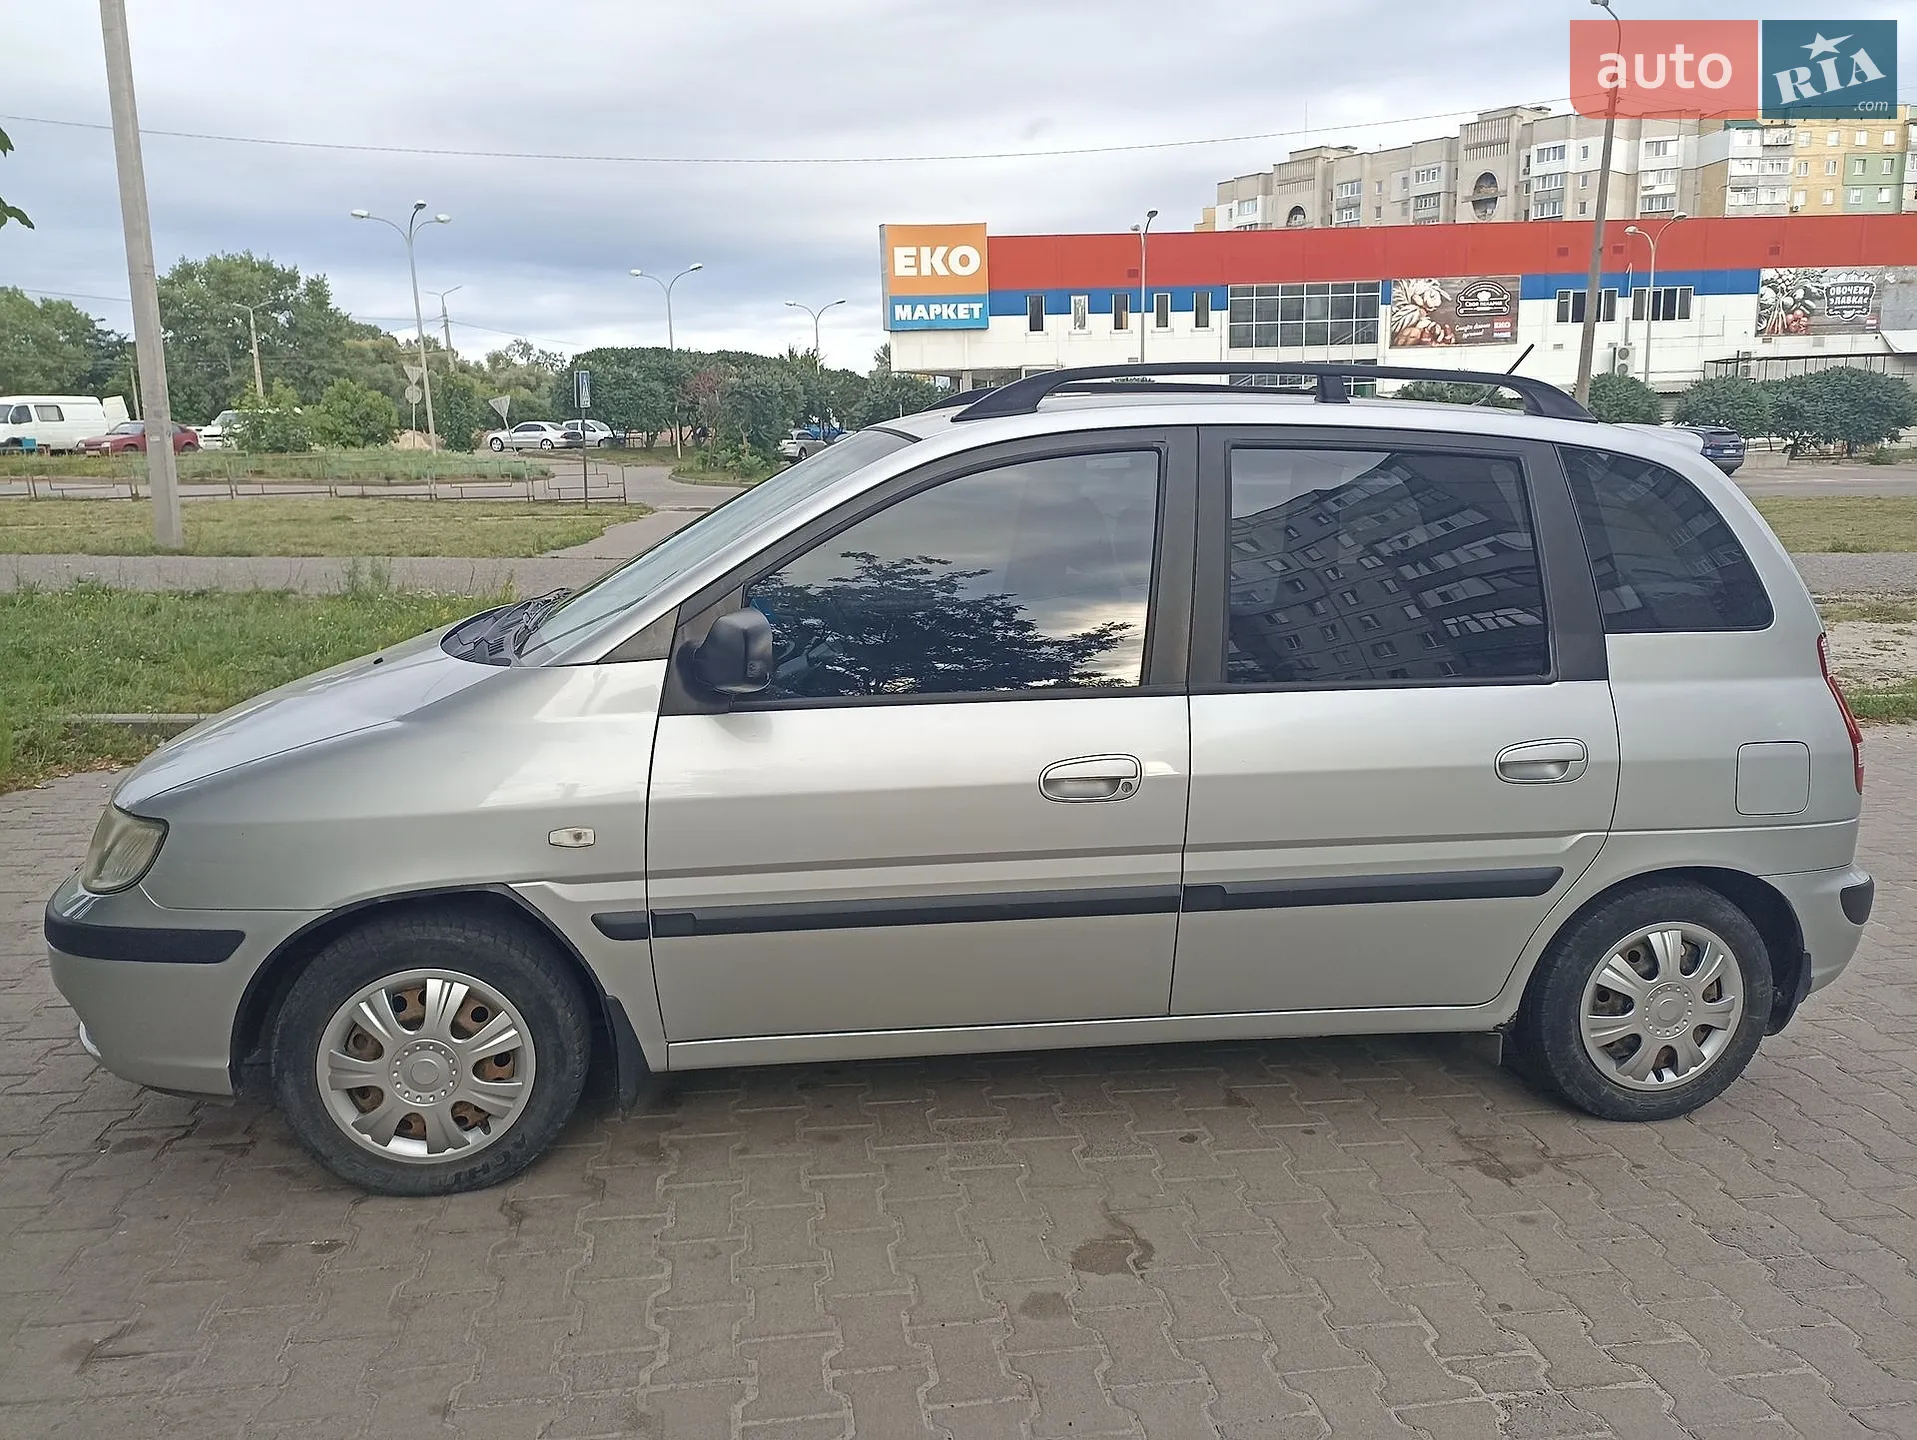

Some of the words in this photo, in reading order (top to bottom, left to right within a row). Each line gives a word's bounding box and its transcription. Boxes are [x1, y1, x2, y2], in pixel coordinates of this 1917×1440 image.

[893, 245, 981, 277] ЕКО
[1829, 285, 1870, 296] ОВОЧЕВА
[894, 303, 984, 321] МАРКЕТ
